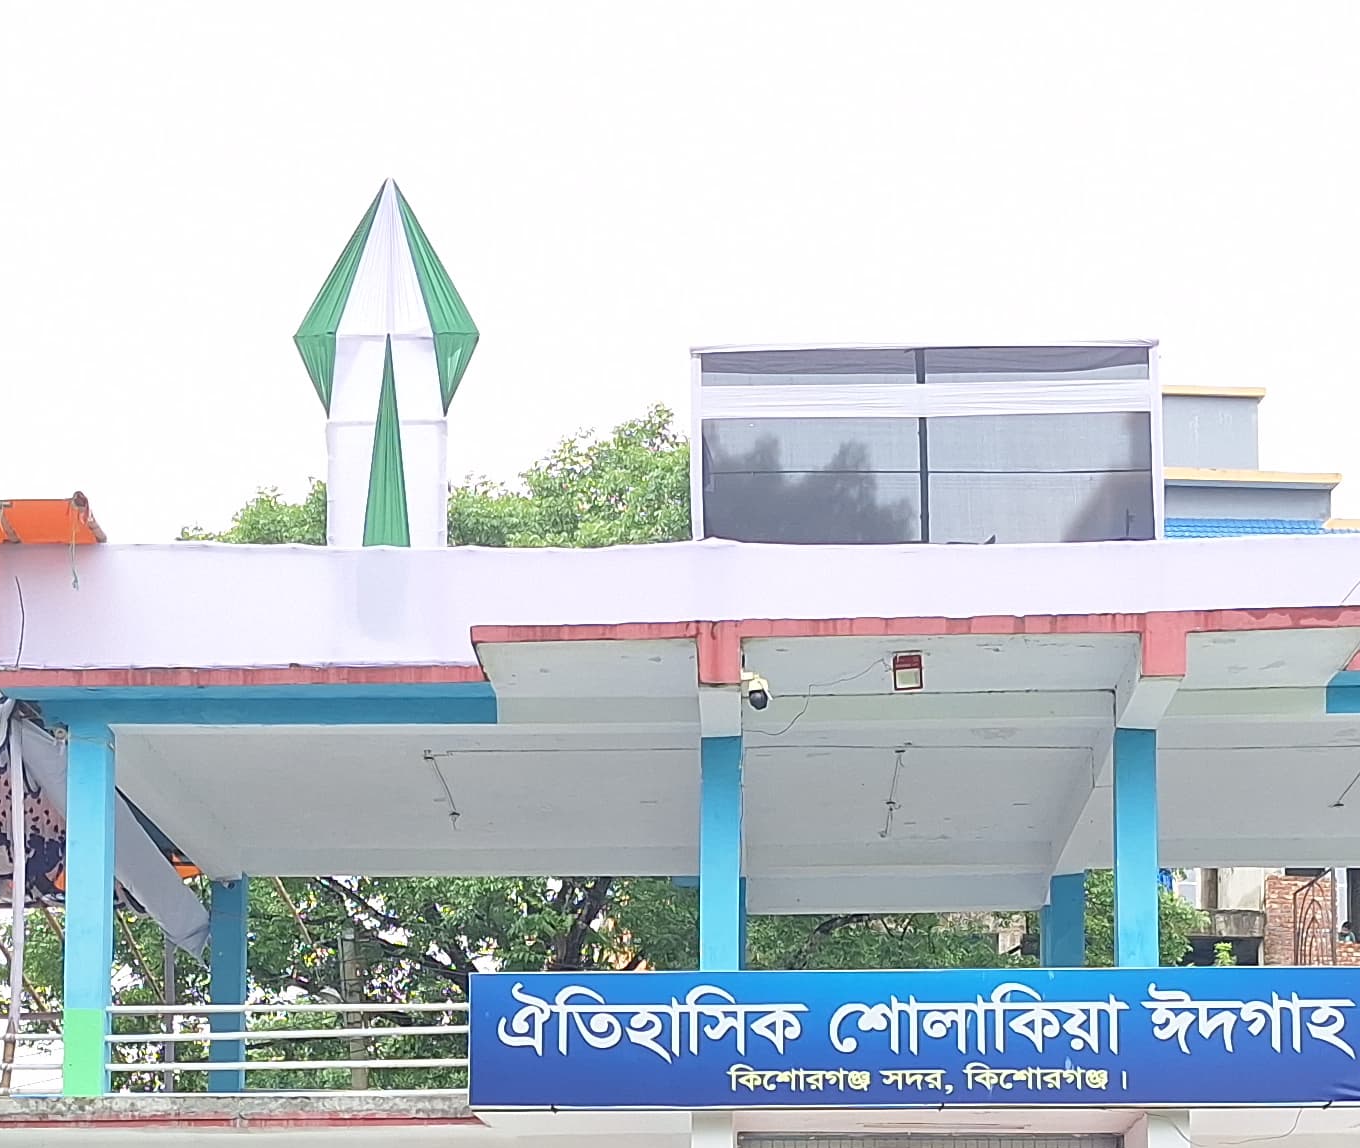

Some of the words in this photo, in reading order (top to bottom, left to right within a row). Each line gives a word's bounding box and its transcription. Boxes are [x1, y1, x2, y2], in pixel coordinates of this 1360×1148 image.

[497, 982, 810, 1064] ঐতিহাসিক
[829, 982, 1130, 1056] শোলাকিয়া
[1141, 982, 1357, 1061] ঈদগাহ
[726, 1063, 872, 1092] কিশোরগঞ্জ
[879, 1069, 954, 1095] সদর,
